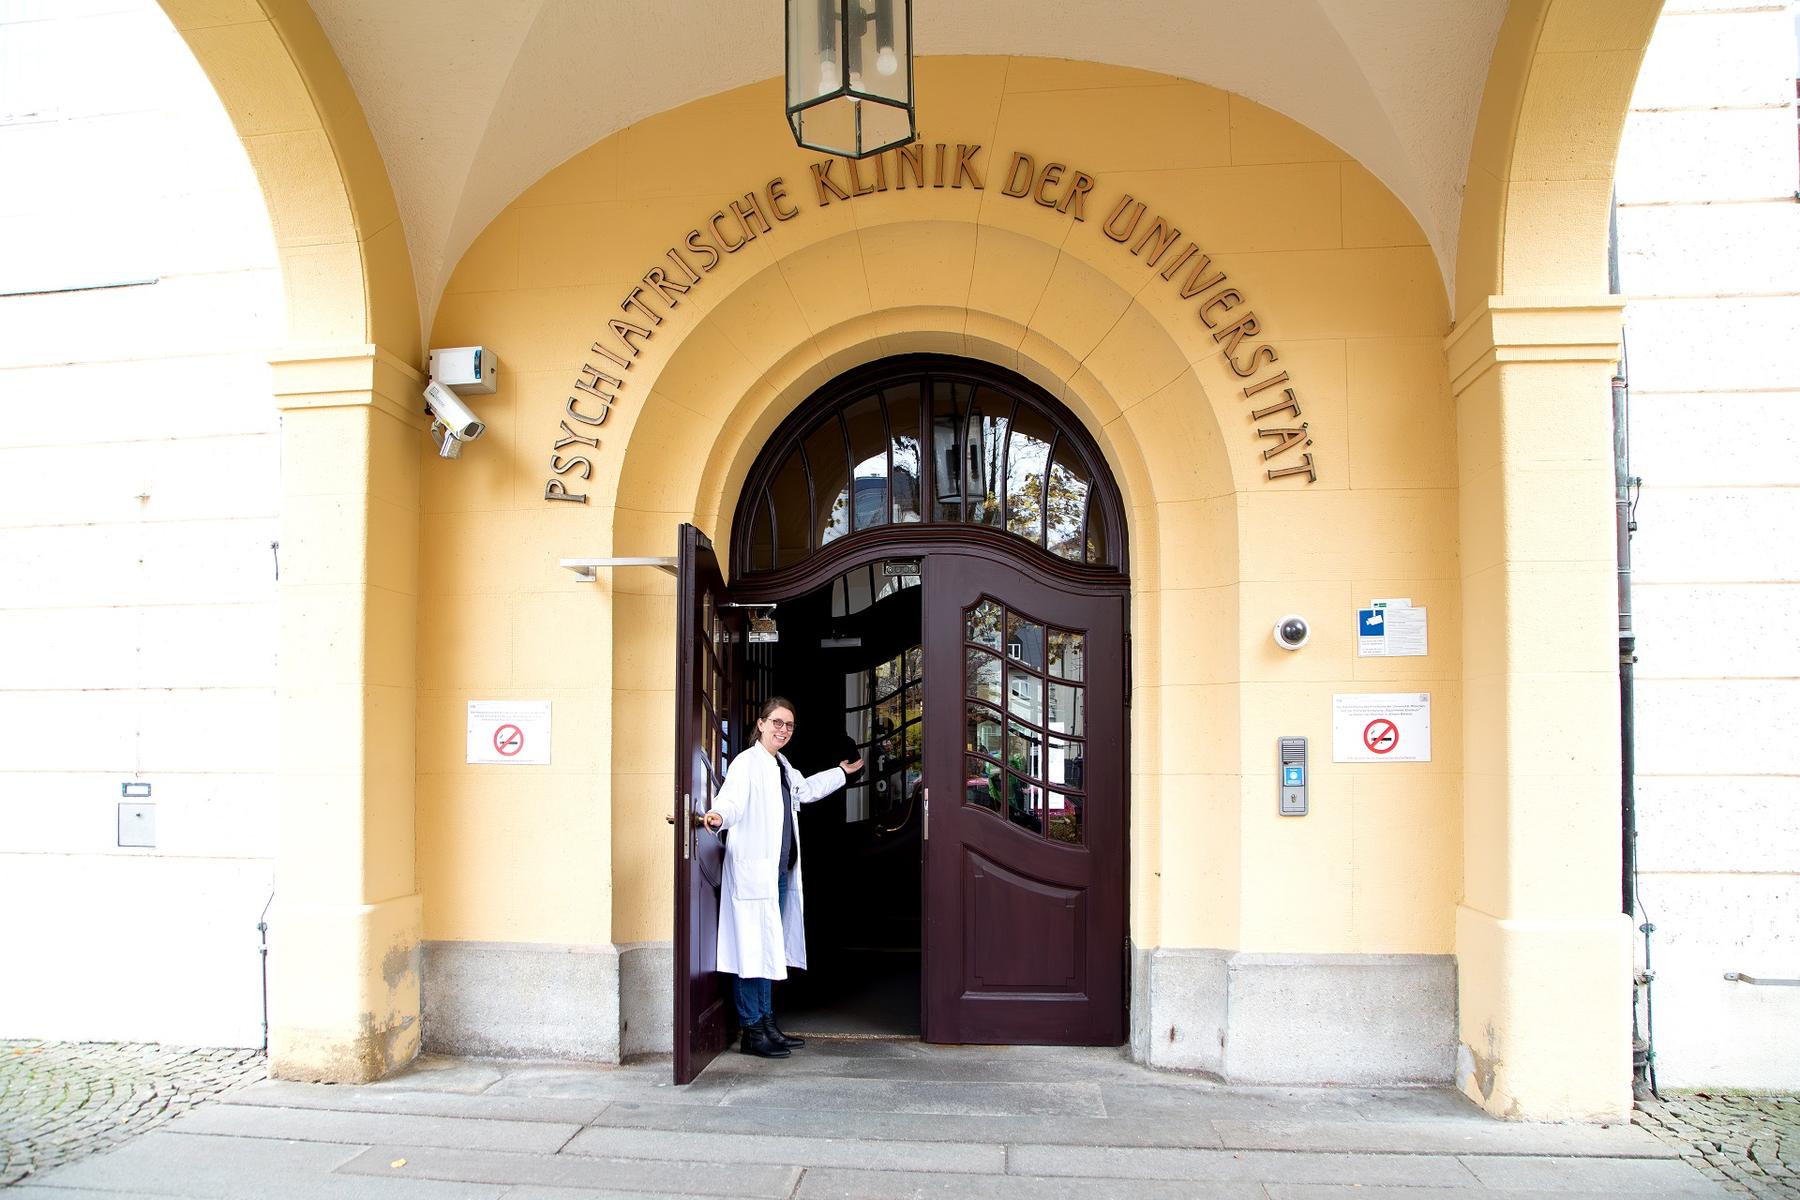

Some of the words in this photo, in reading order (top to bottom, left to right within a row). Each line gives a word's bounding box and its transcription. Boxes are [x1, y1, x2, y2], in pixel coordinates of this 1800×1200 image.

[544, 176, 799, 504] PSYCHIATRISCHE
[809, 143, 985, 207] KLINIK
[1001, 151, 1095, 222] DER
[1102, 194, 1317, 483] UNIVERSITÄT
